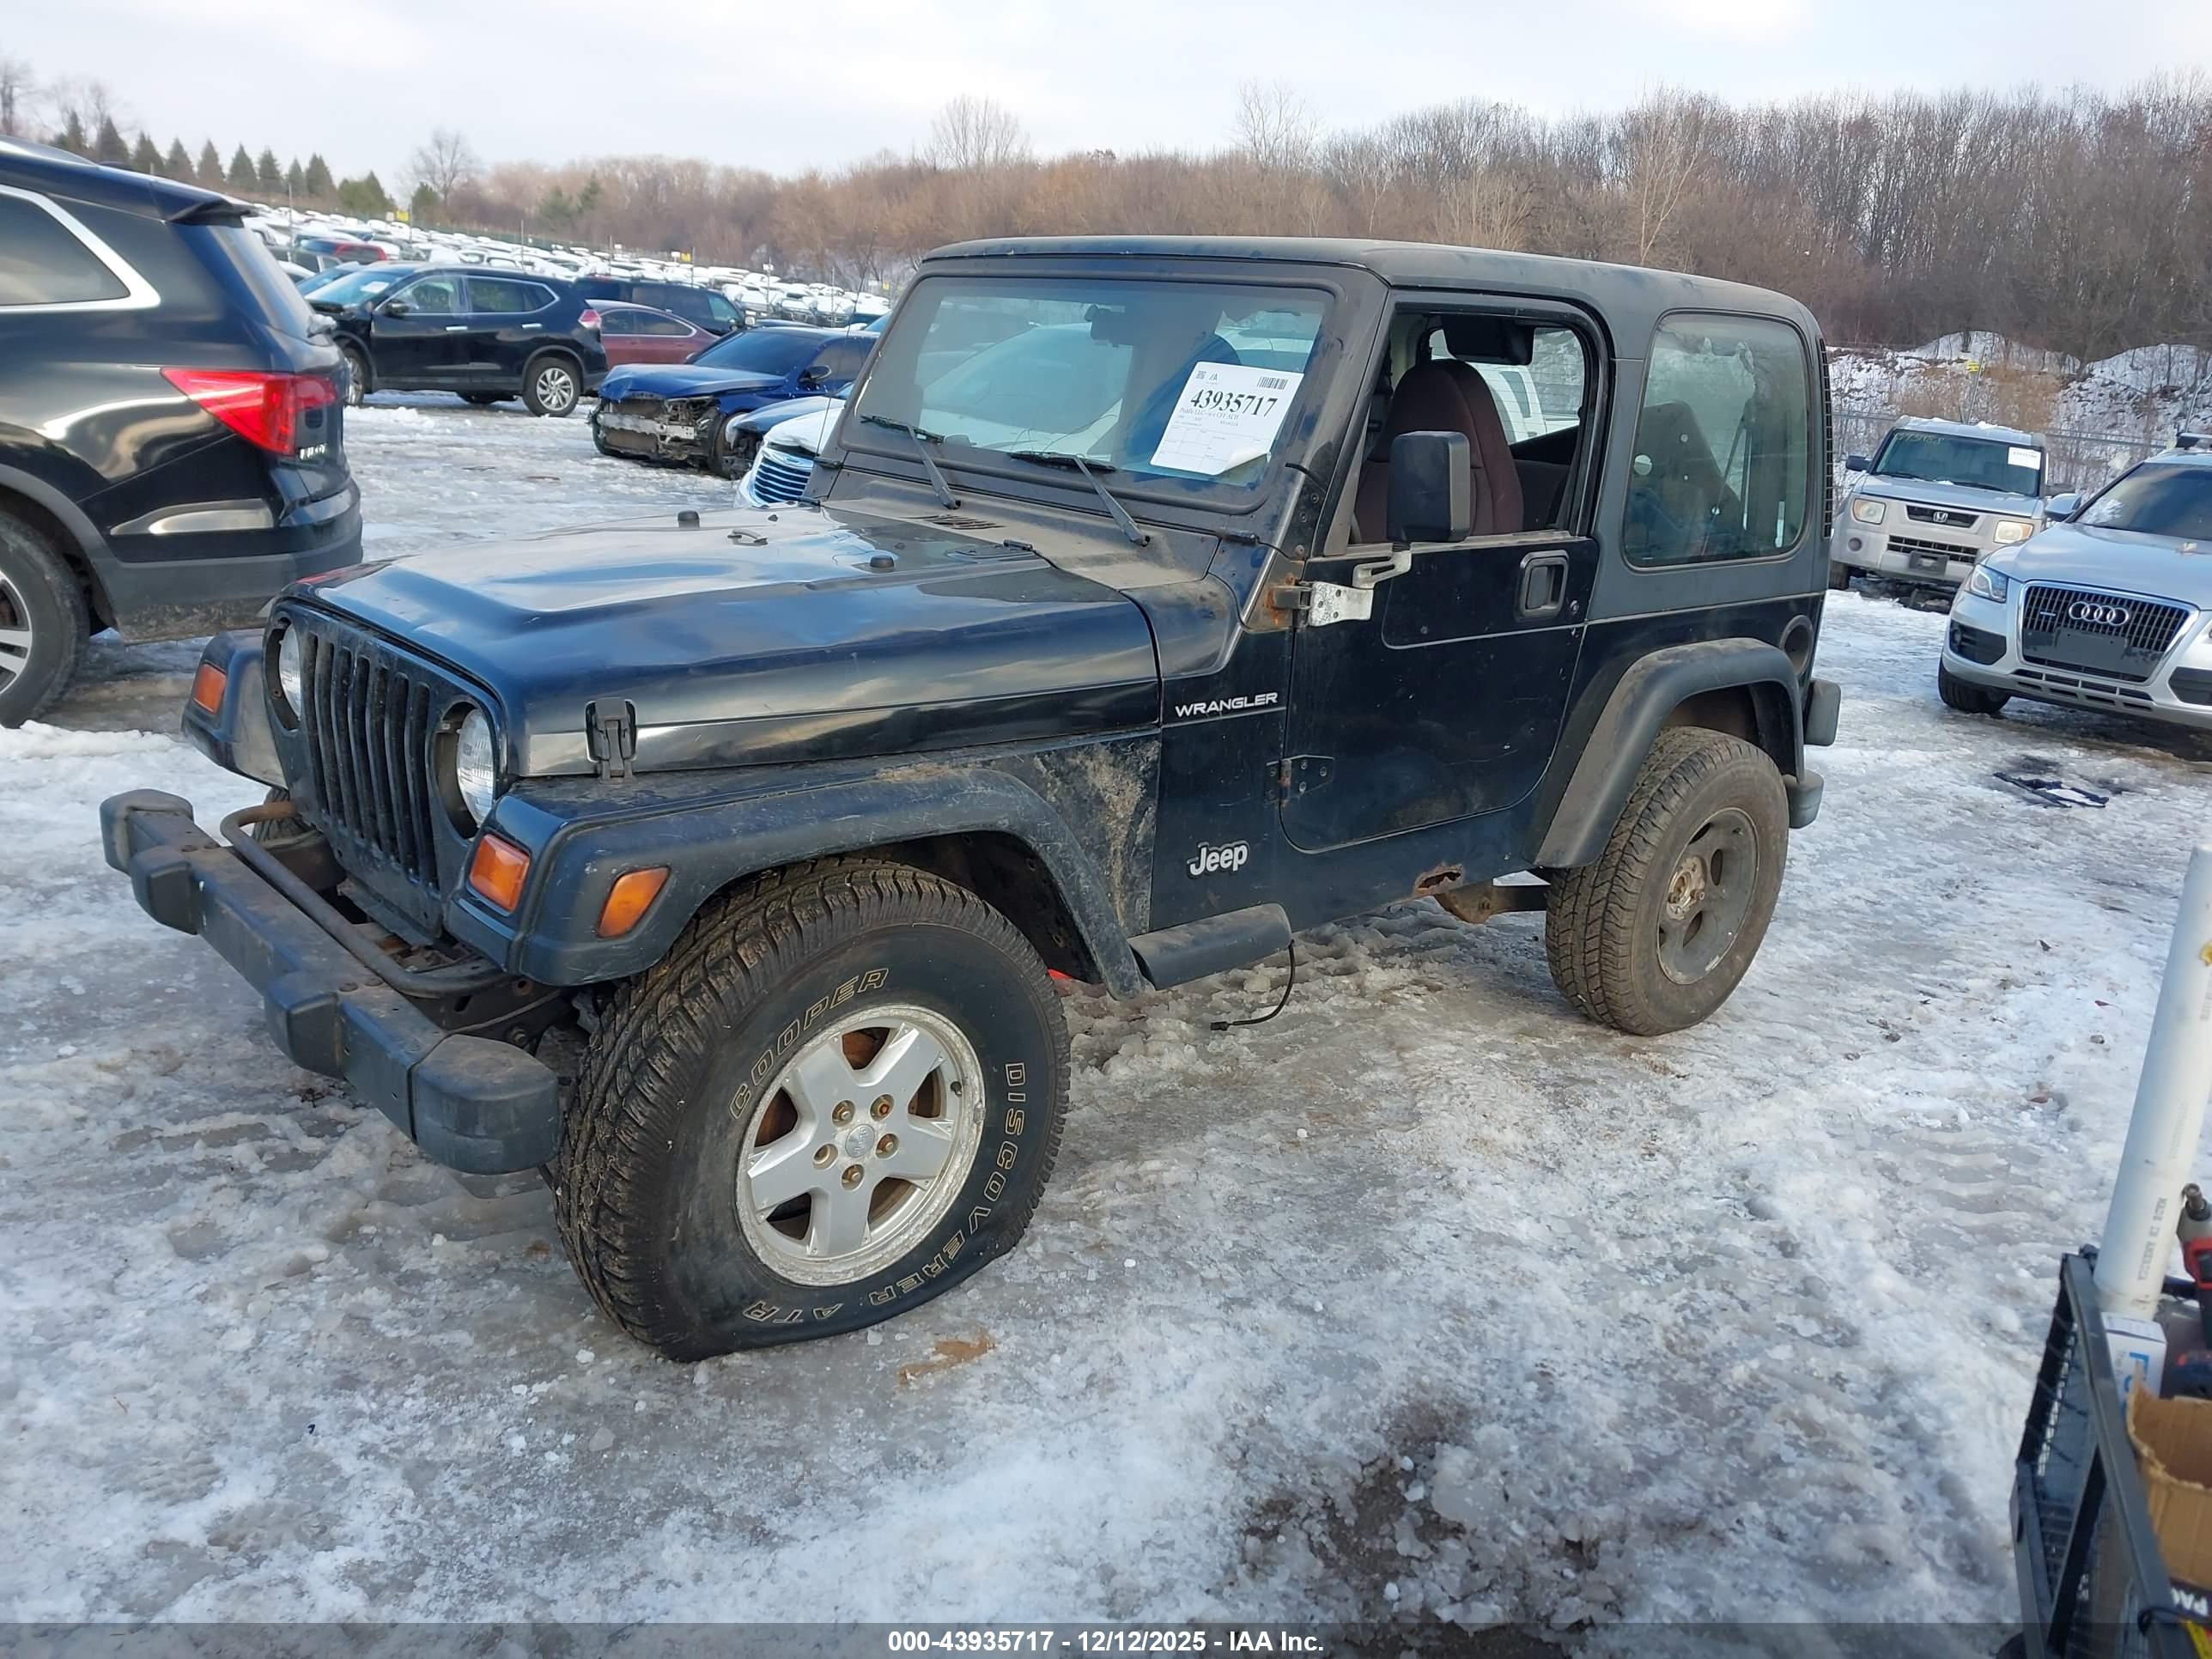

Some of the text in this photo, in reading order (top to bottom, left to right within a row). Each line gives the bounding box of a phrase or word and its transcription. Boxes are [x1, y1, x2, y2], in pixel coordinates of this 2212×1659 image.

[1190, 389, 1279, 417] 43935717
[1175, 692, 1279, 718] WRANGLER
[1187, 841, 1249, 877] Jeep
[728, 968, 889, 1120] COOPER
[868, 1061, 1026, 1306] DISCOVERER
